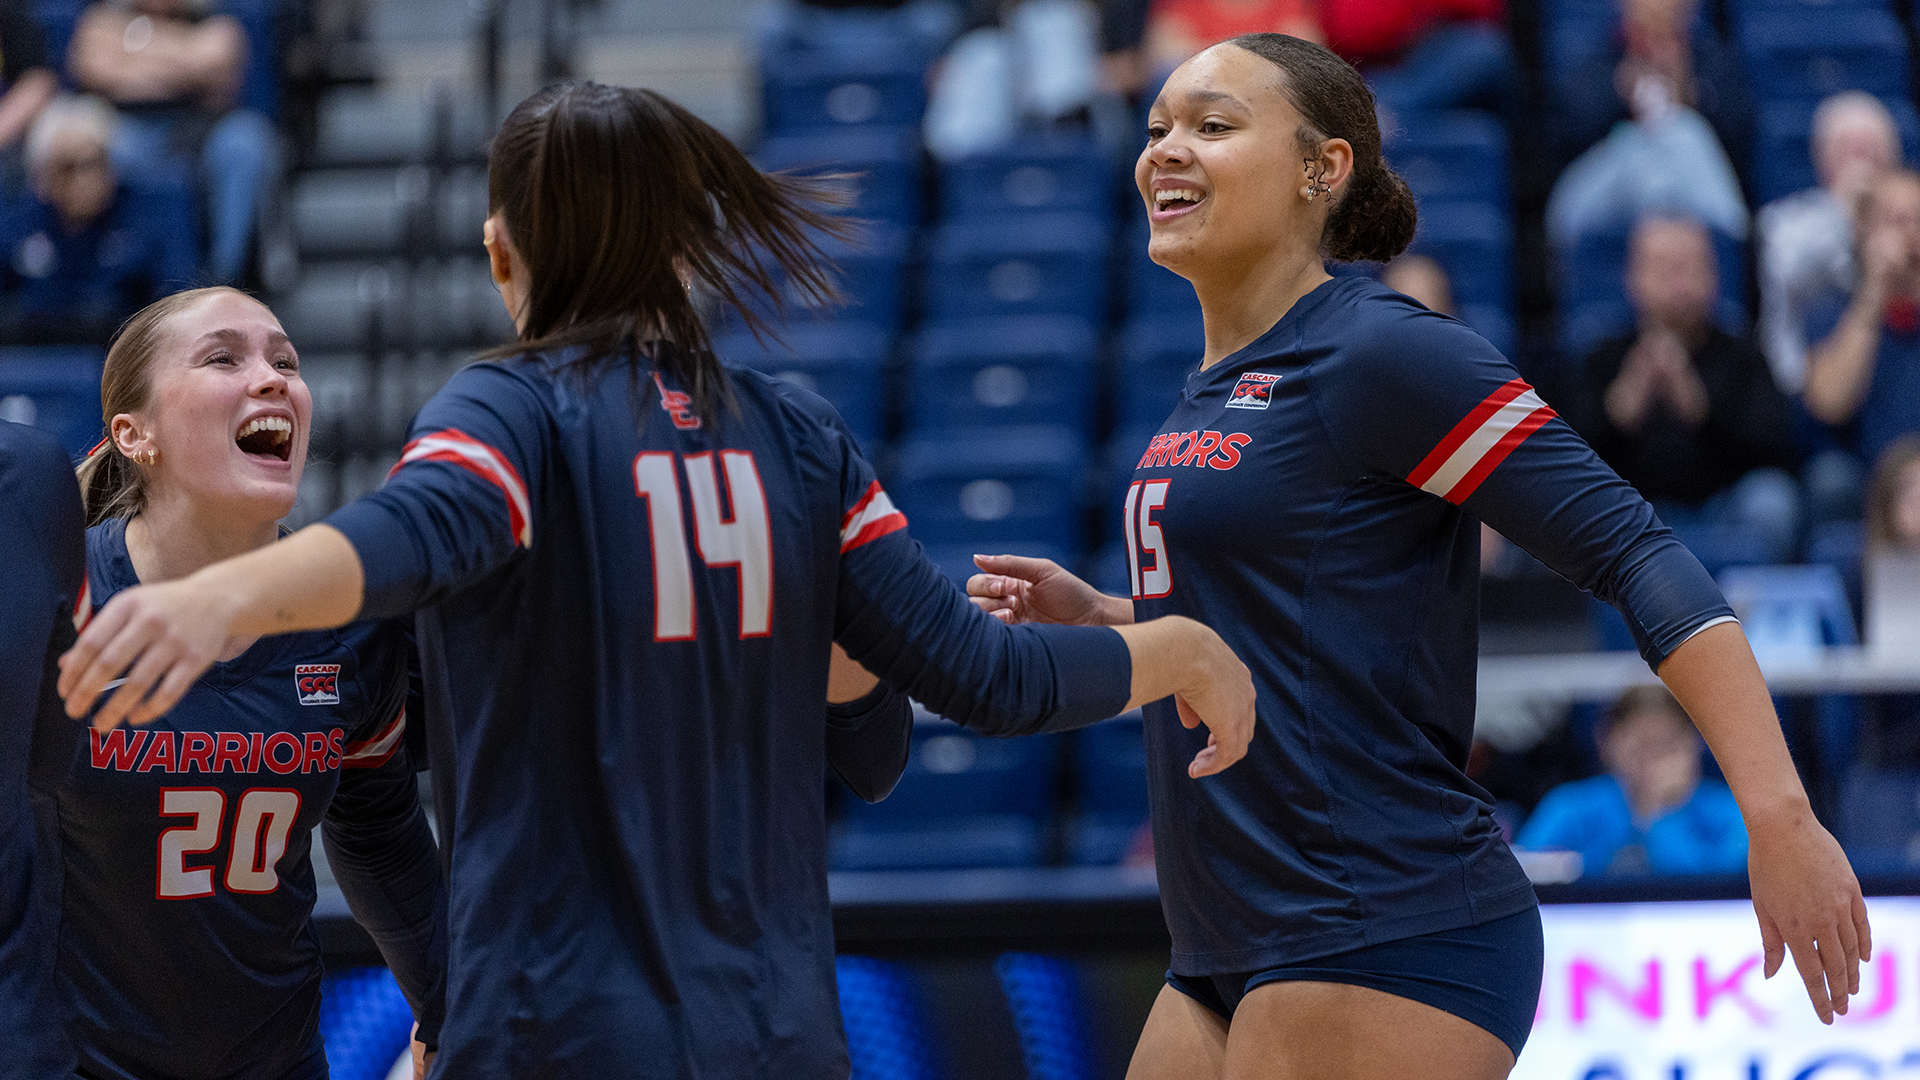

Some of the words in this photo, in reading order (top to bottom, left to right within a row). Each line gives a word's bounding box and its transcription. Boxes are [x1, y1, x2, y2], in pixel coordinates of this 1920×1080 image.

[1235, 383, 1271, 397] CCC
[1135, 430, 1252, 471] RRIORS
[632, 448, 774, 642] 14
[1124, 478, 1174, 600] 15
[299, 676, 336, 692] CCC
[88, 726, 344, 774] WARRIORS
[156, 786, 302, 900] 20
[1535, 955, 1783, 1025] NK
